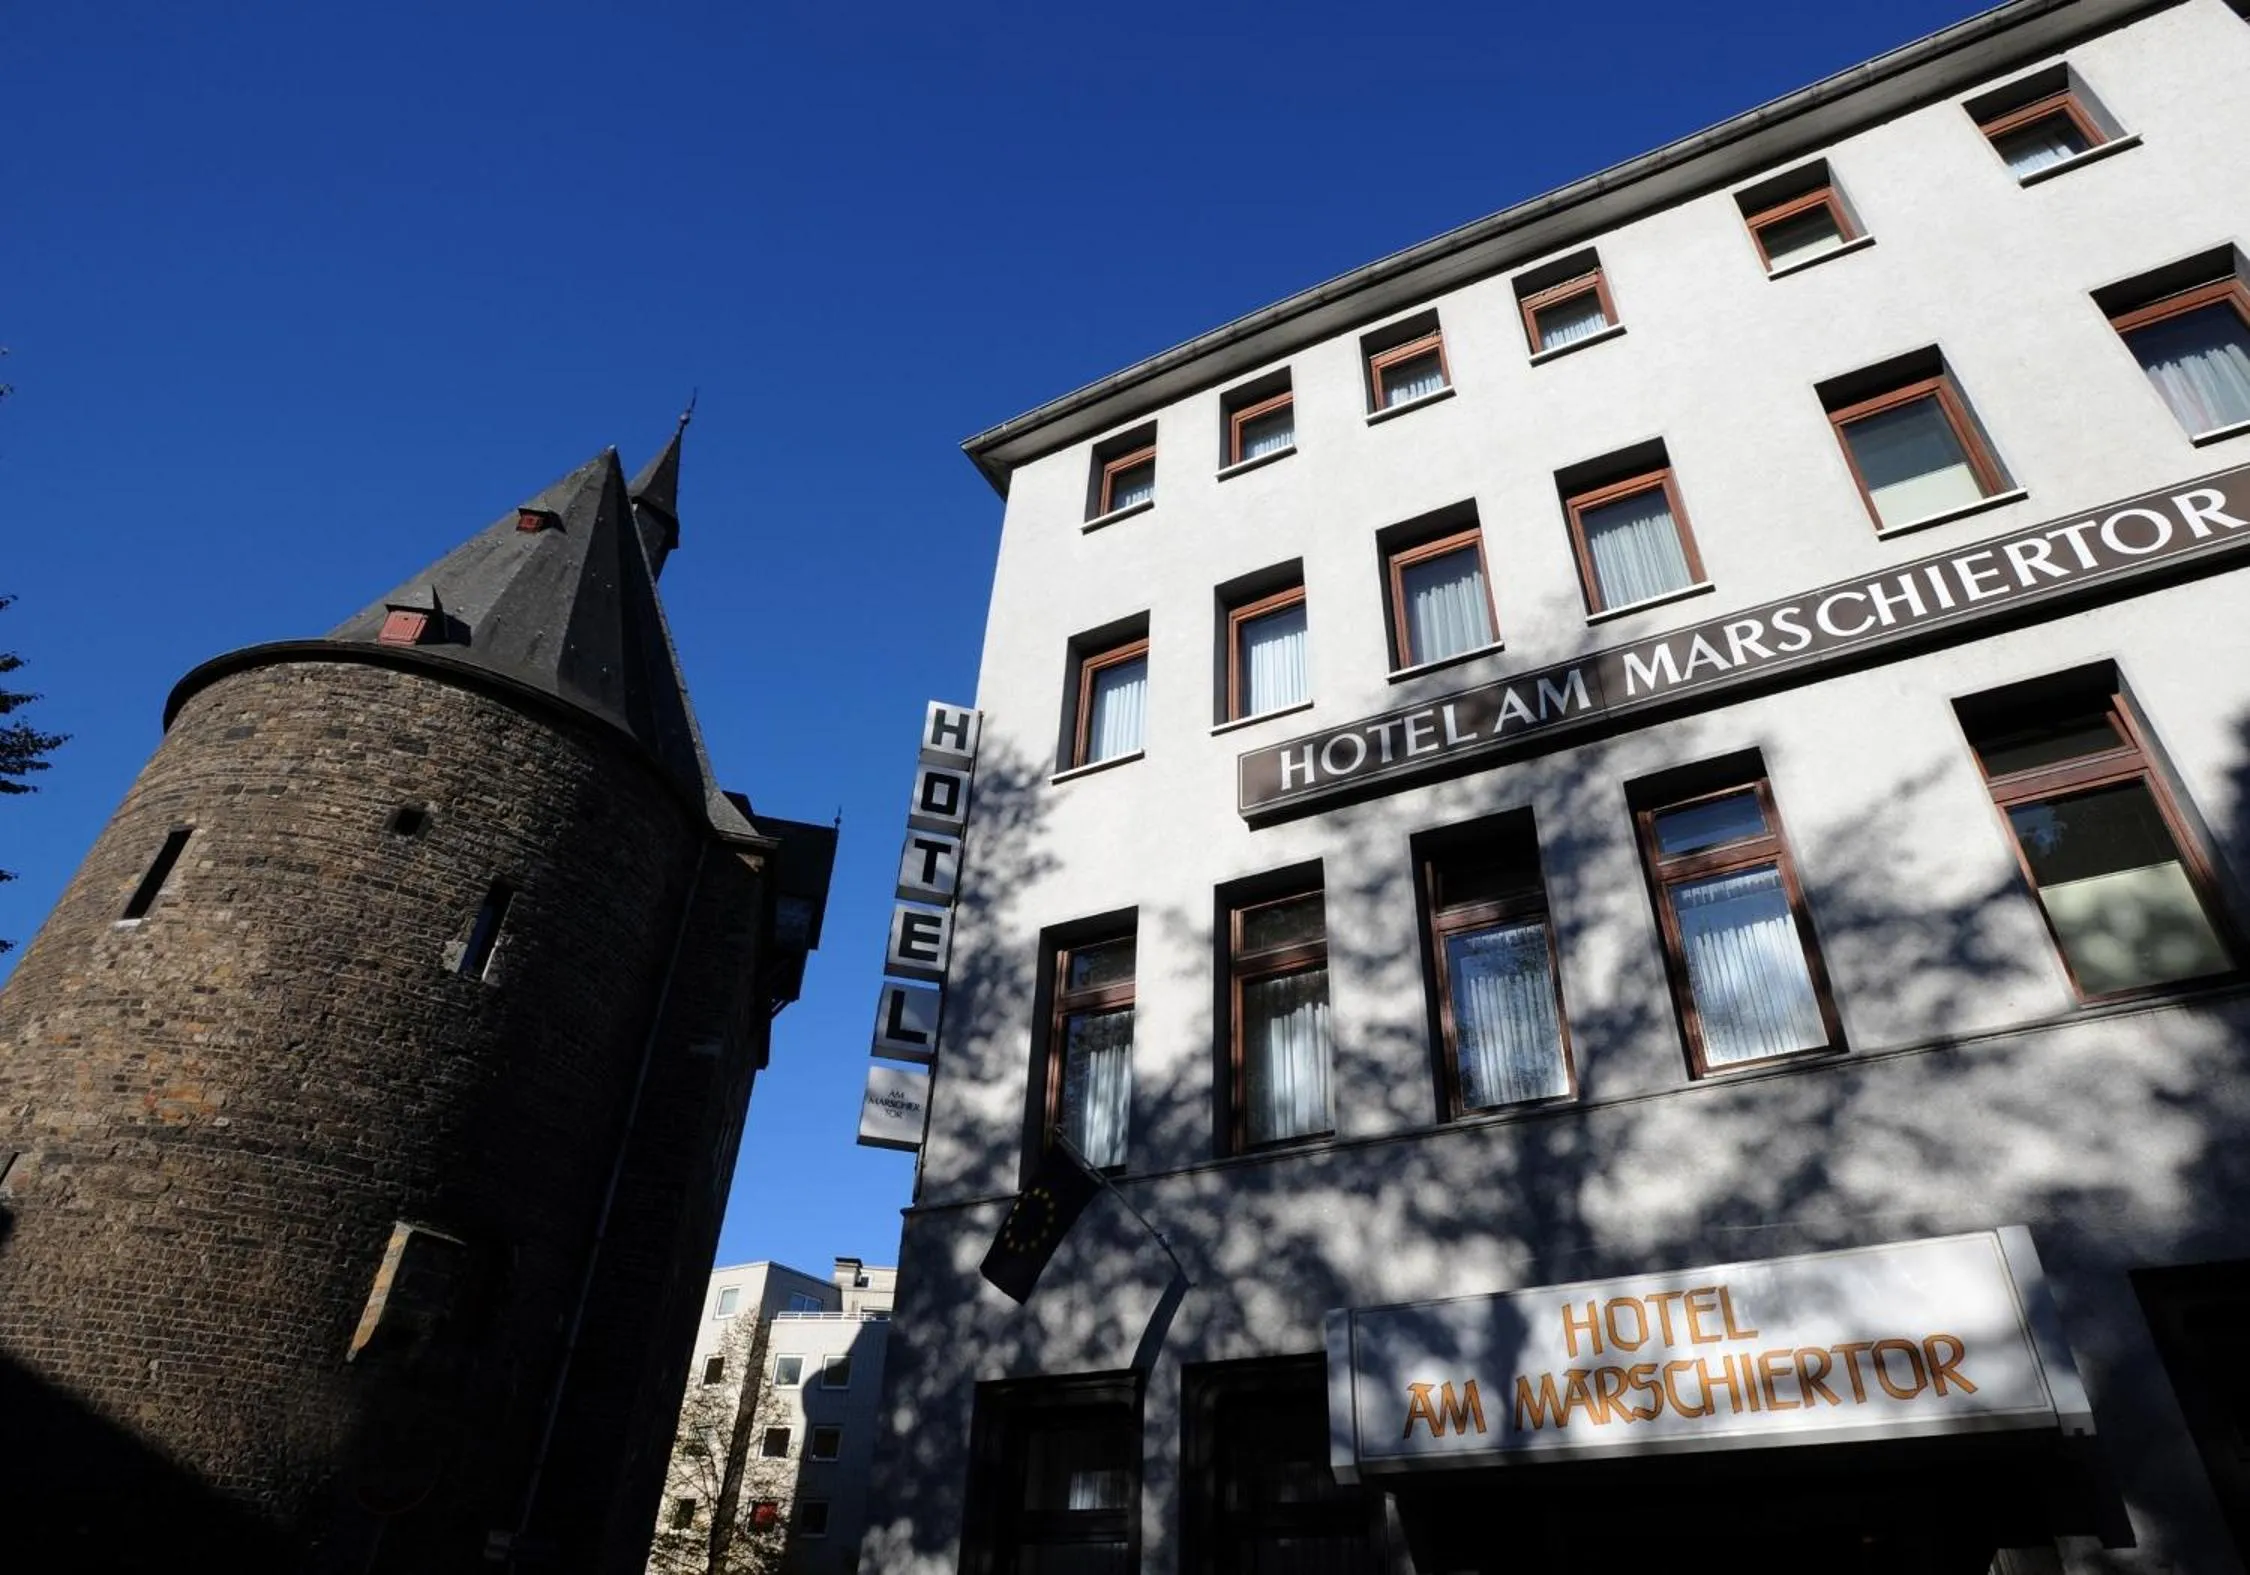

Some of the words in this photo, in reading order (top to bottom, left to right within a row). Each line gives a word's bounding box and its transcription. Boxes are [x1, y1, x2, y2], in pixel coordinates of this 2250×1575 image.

[1281, 703, 1477, 792] HOTEL
[1493, 669, 1591, 734] AM
[1622, 488, 2250, 695] MARSCHIERTOR
[886, 709, 969, 1044] HOTEL
[1403, 1379, 1487, 1438] AM
[1514, 1333, 1979, 1431] MARSCHIERTOR
[1562, 1285, 1758, 1358] HOTEL
